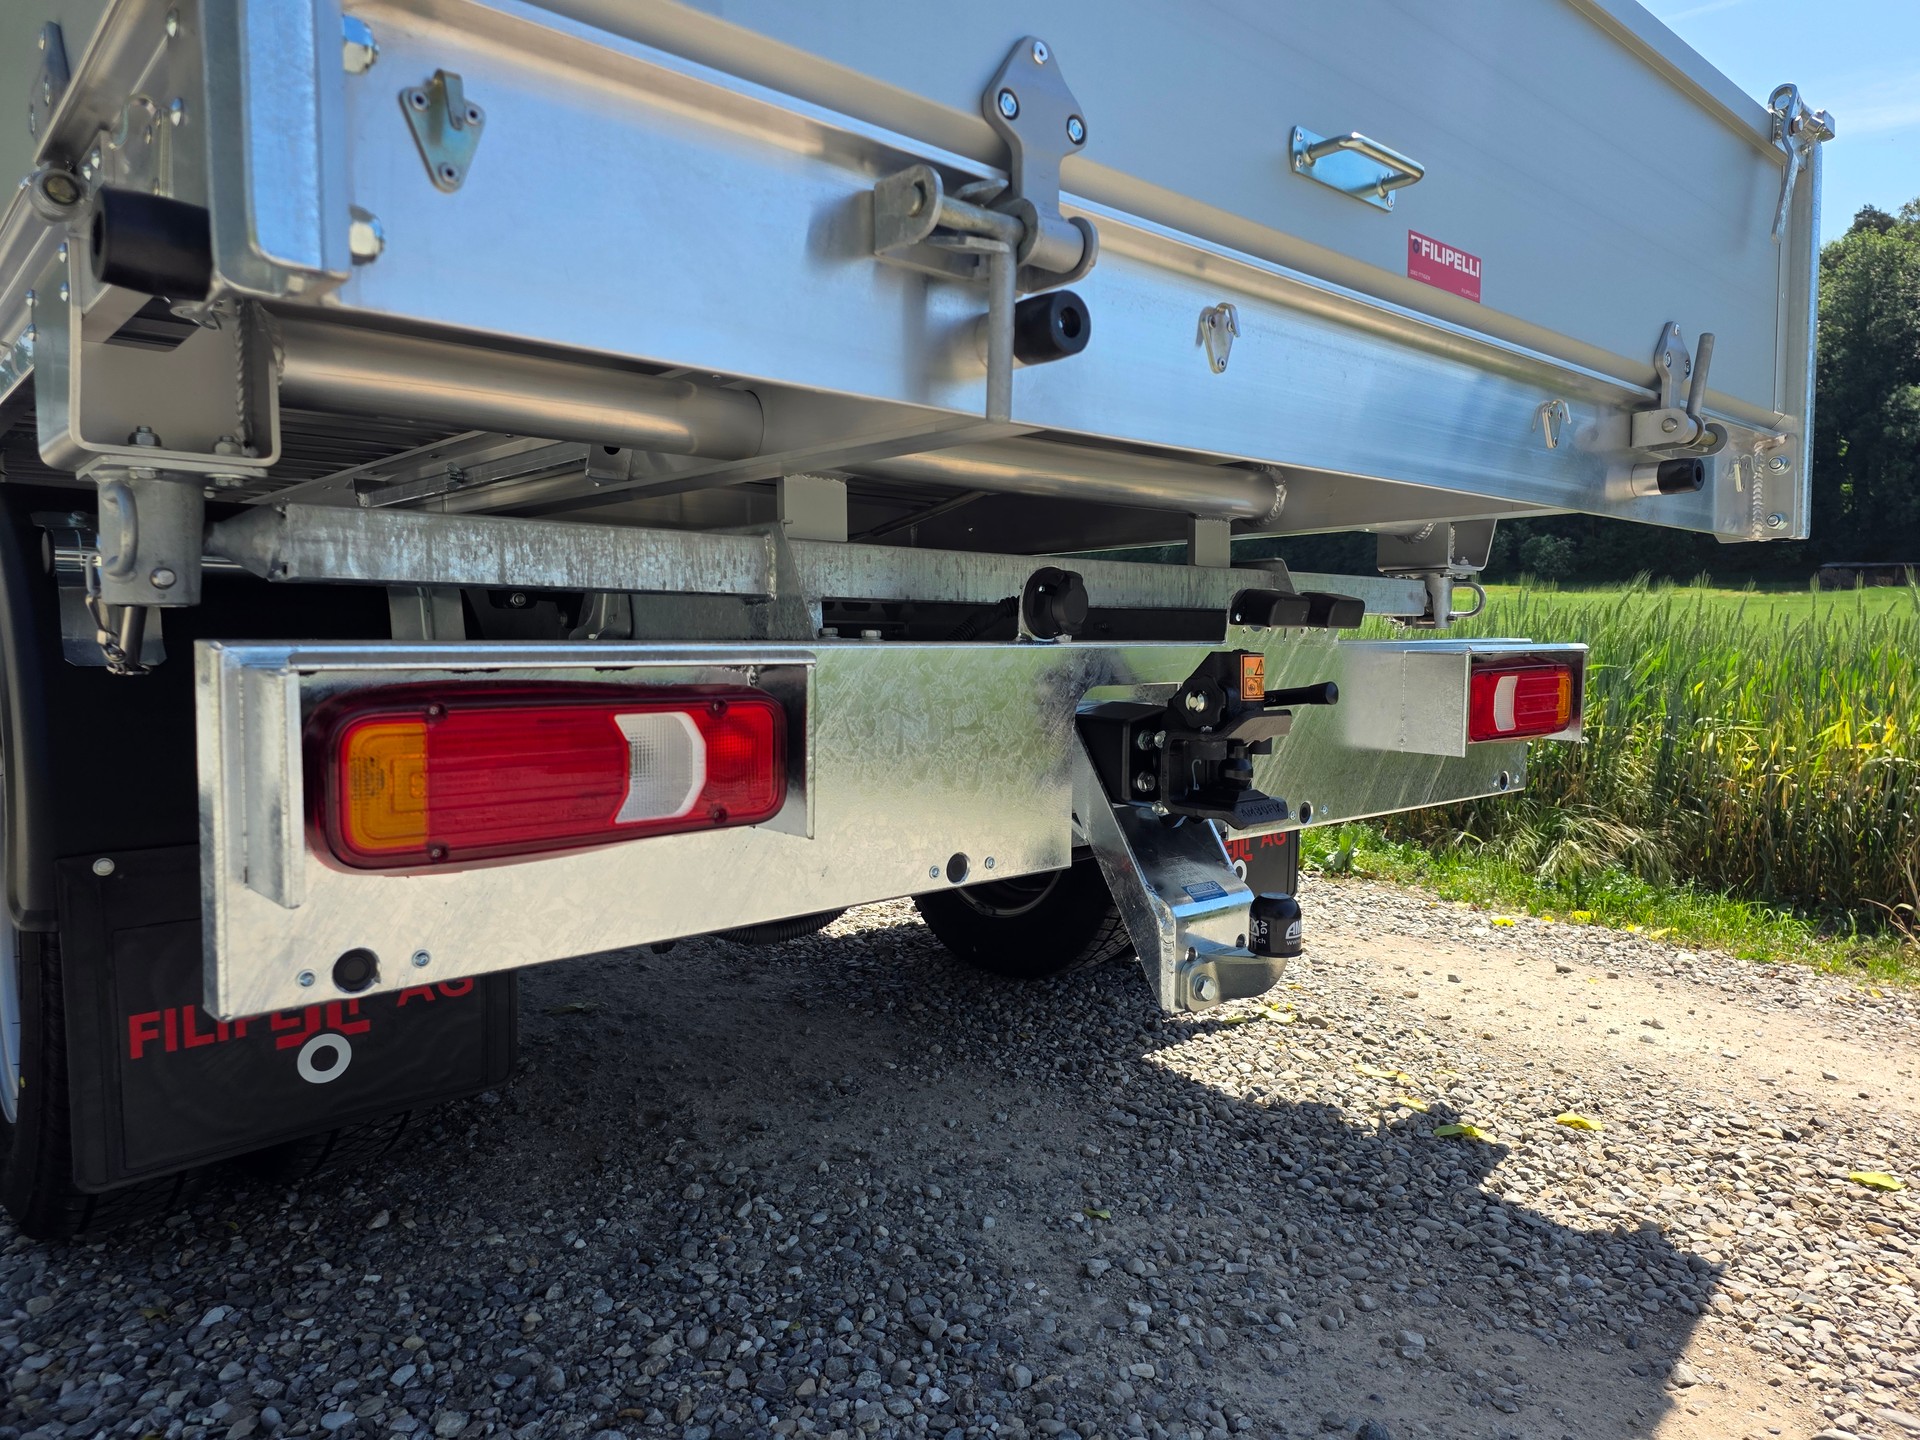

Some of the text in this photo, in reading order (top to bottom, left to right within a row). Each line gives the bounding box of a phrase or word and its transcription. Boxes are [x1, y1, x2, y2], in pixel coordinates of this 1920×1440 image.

[1422, 239, 1480, 278] FILIPELLI
[1261, 832, 1287, 848] AG
[1260, 920, 1268, 935] AG
